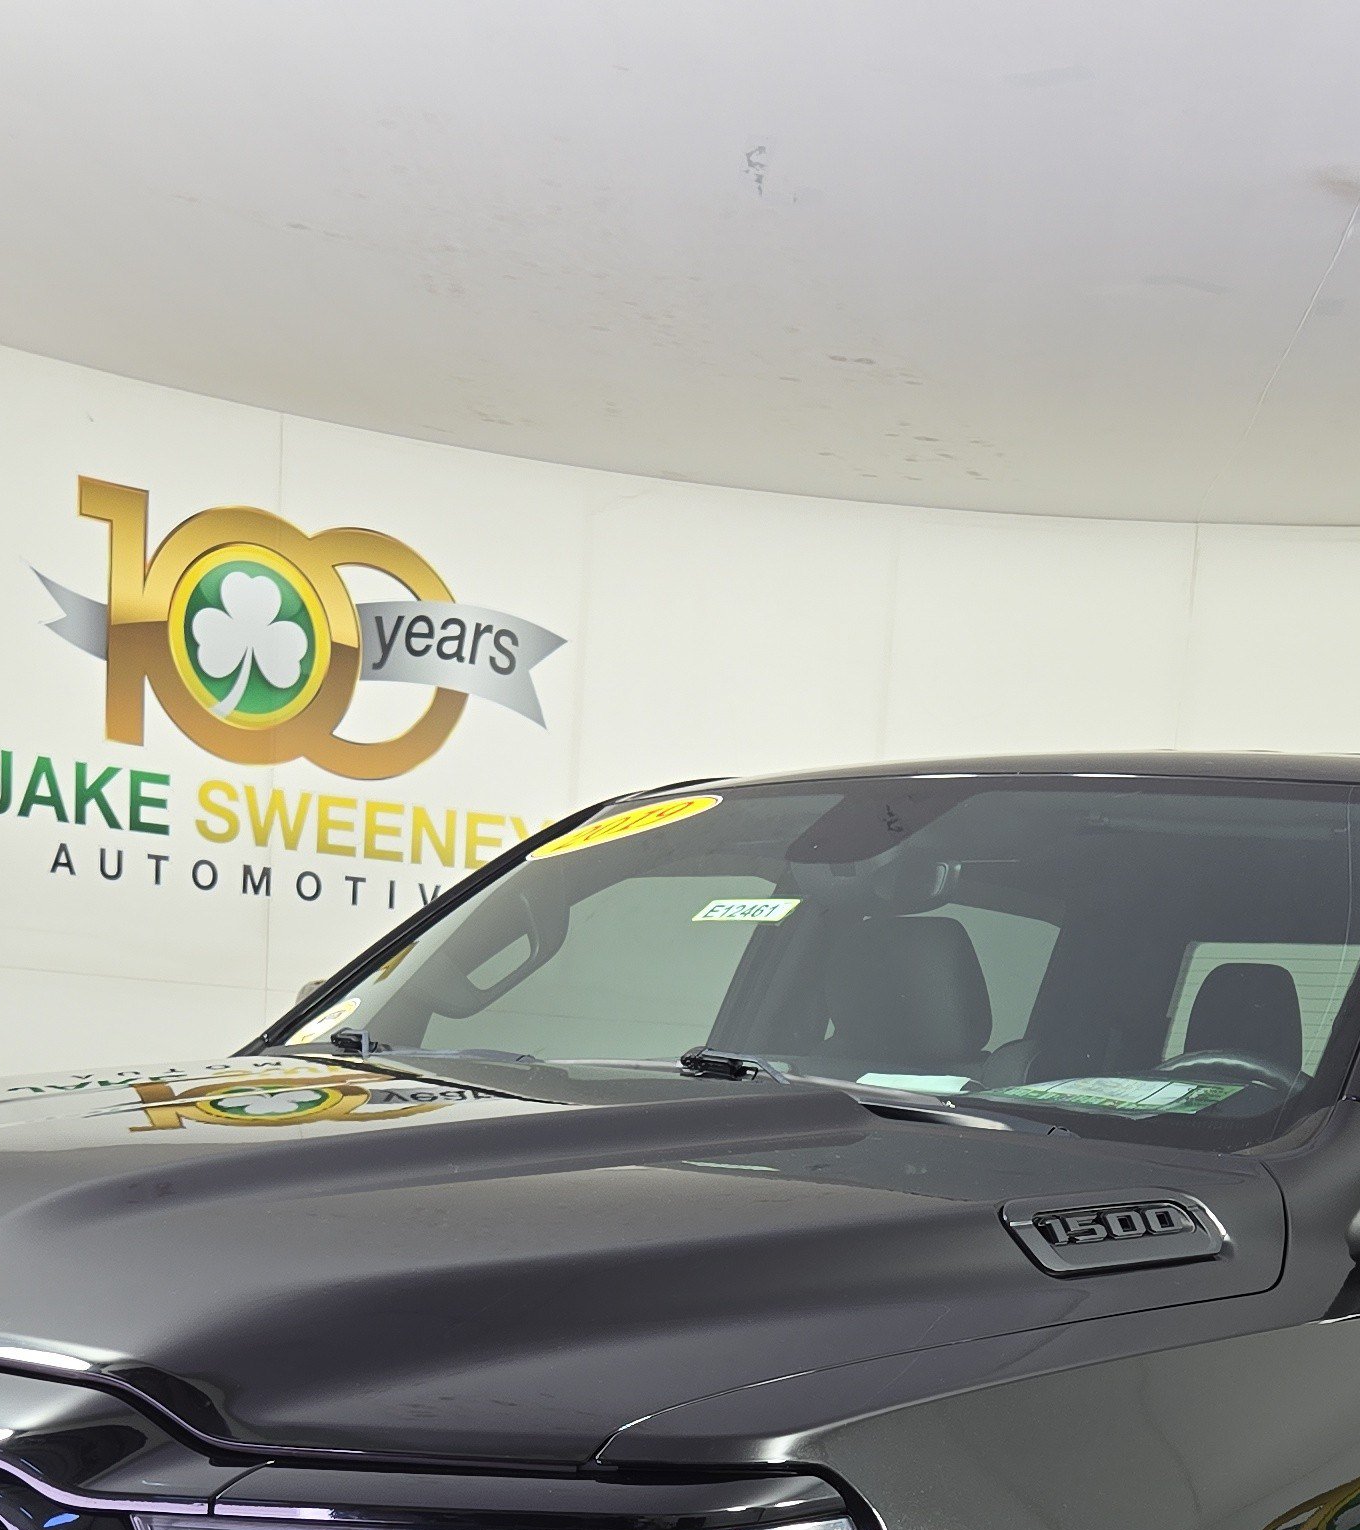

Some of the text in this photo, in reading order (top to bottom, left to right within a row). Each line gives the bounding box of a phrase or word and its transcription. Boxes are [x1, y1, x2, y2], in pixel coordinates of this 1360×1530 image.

[77, 474, 470, 781] 100
[371, 608, 519, 676] years
[49, 842, 442, 909] AUTOMOTIV
[1042, 1208, 1184, 1247] 1500
